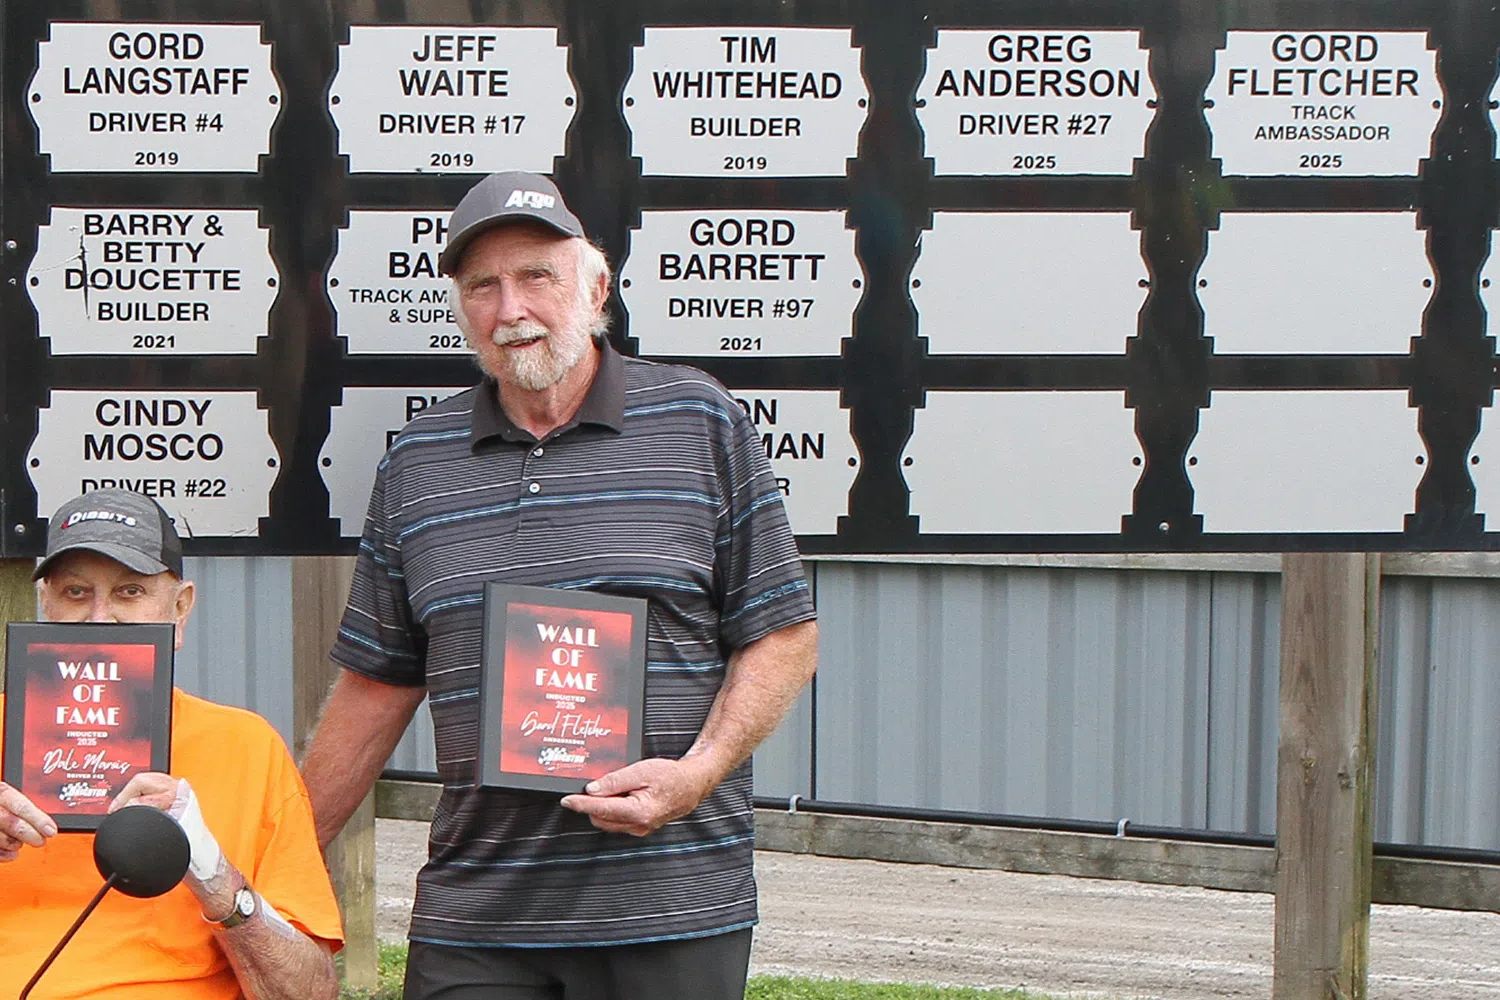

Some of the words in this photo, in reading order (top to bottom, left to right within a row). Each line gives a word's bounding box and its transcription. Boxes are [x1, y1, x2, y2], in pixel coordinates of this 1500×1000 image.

[108, 31, 204, 60] GORD
[412, 35, 497, 62] JEFF
[720, 36, 776, 64] TIM
[988, 34, 1091, 63] GREG
[1272, 34, 1378, 62] GORD
[64, 67, 250, 95] LANGSTAFF
[399, 69, 509, 97] WAITE
[652, 71, 842, 99] WHITEHEAD
[934, 69, 1140, 98] ANDERSON
[1228, 68, 1419, 96] FLETCHER
[89, 112, 187, 133] DRIVER
[195, 113, 224, 133] #4
[1291, 105, 1355, 120] TRACK
[379, 114, 475, 134] DRIVER
[483, 115, 526, 134] #17
[690, 117, 801, 137] BUILDER
[959, 114, 1059, 135] DRIVER
[1067, 114, 1112, 135] #27
[1254, 125, 1390, 141] AMBASSADOR
[134, 151, 179, 166] 2019
[430, 153, 474, 167] 2019
[723, 156, 767, 170] 2019
[1013, 155, 1056, 169] 2025
[1299, 154, 1342, 168] 2025
[84, 214, 194, 236] BARRY
[203, 214, 224, 237] &
[412, 216, 449, 245] PH
[689, 218, 795, 247] GORD
[103, 241, 206, 264] BETTY
[659, 253, 826, 281] BARRETT
[64, 268, 242, 292] DOUCETTE
[349, 288, 413, 304] TRACK
[98, 302, 209, 322] BUILDER
[388, 308, 401, 324] &
[406, 308, 457, 324] SUPE
[668, 298, 764, 318] DRIVER
[772, 298, 814, 319] #97
[132, 335, 175, 349] 2021
[720, 337, 761, 351] 2021
[95, 398, 212, 427] CINDY
[84, 433, 224, 461] MOSCO
[184, 478, 227, 498] #22
[536, 623, 600, 647] WALL
[551, 647, 585, 667] OF
[58, 661, 121, 681] WALL
[535, 668, 598, 692] FAME
[73, 684, 106, 703] OF
[545, 693, 586, 703] INDUCTED
[56, 706, 120, 726] FAME
[561, 713, 611, 738] Fletcher
[43, 748, 80, 774] Dale
